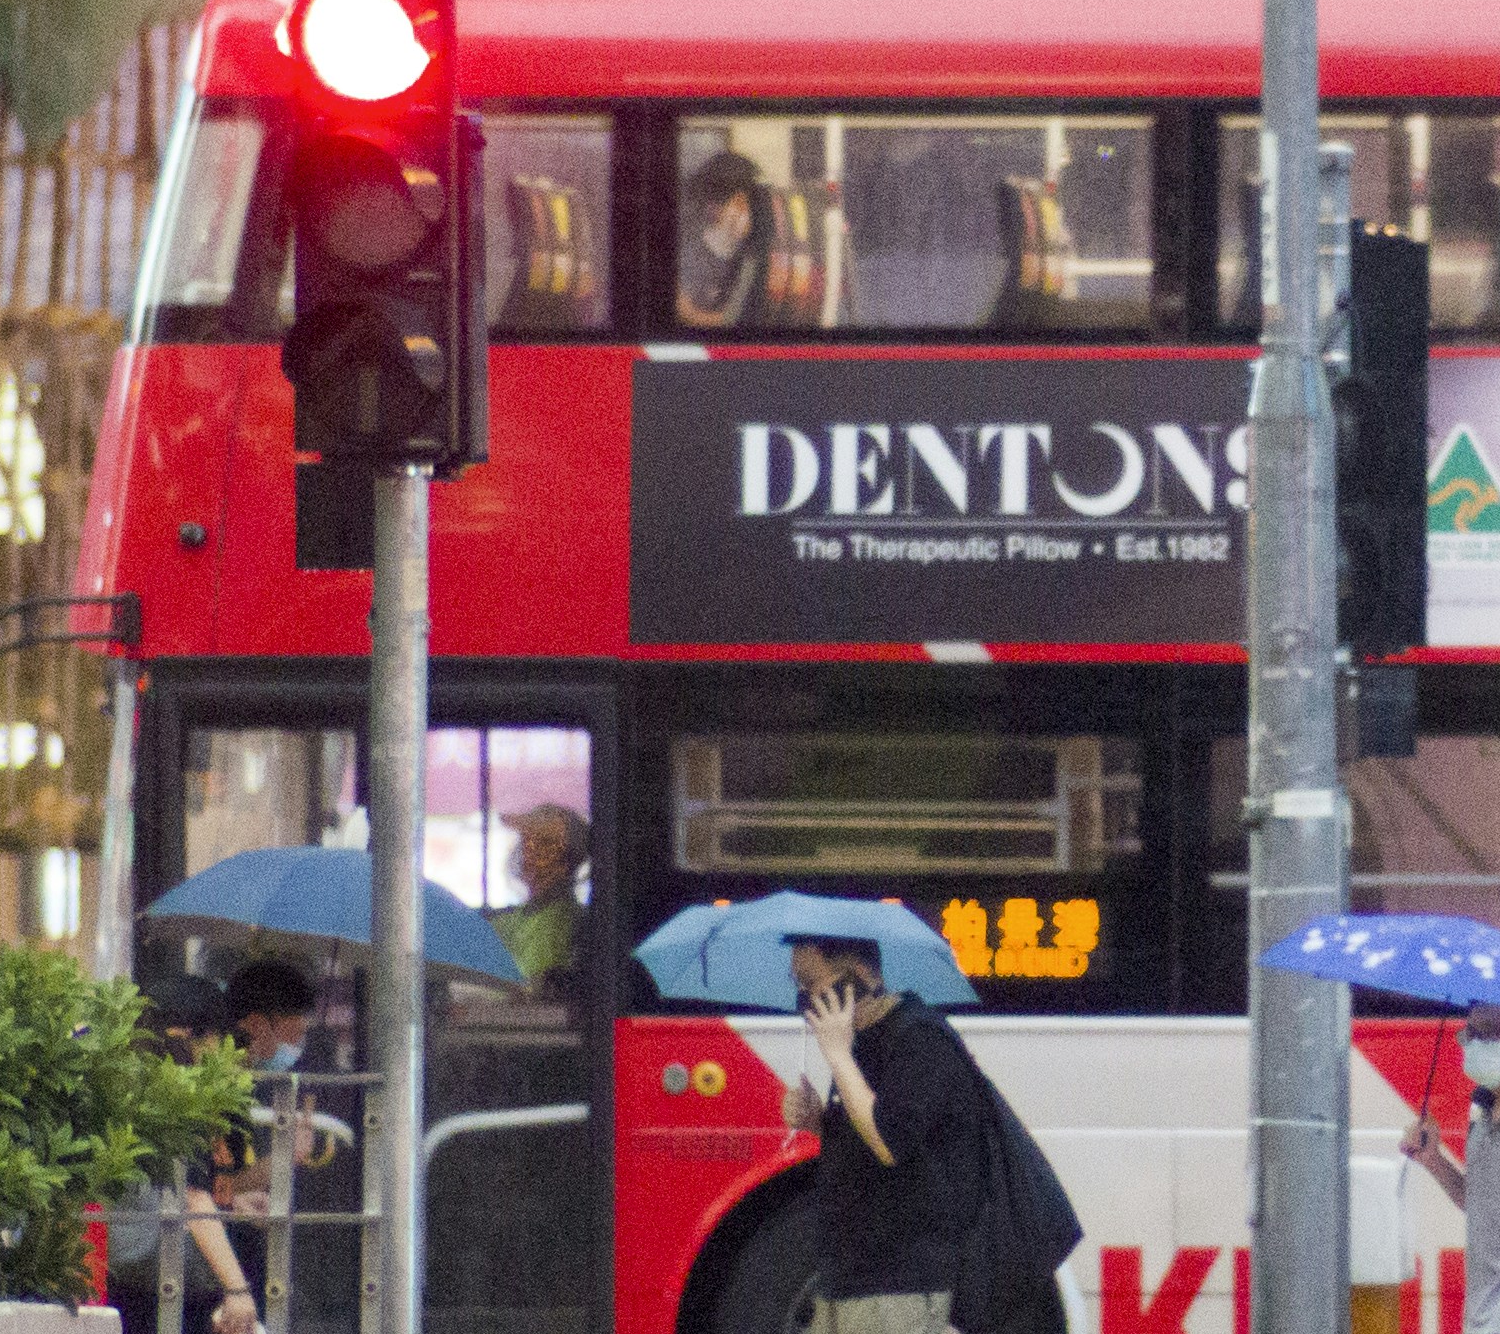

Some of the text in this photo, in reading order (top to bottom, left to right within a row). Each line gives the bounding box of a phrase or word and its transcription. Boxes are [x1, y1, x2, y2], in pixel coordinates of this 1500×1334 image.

[793, 535, 841, 562] The
[850, 535, 999, 567] Therapeutic
[1006, 534, 1083, 562] Pillow
